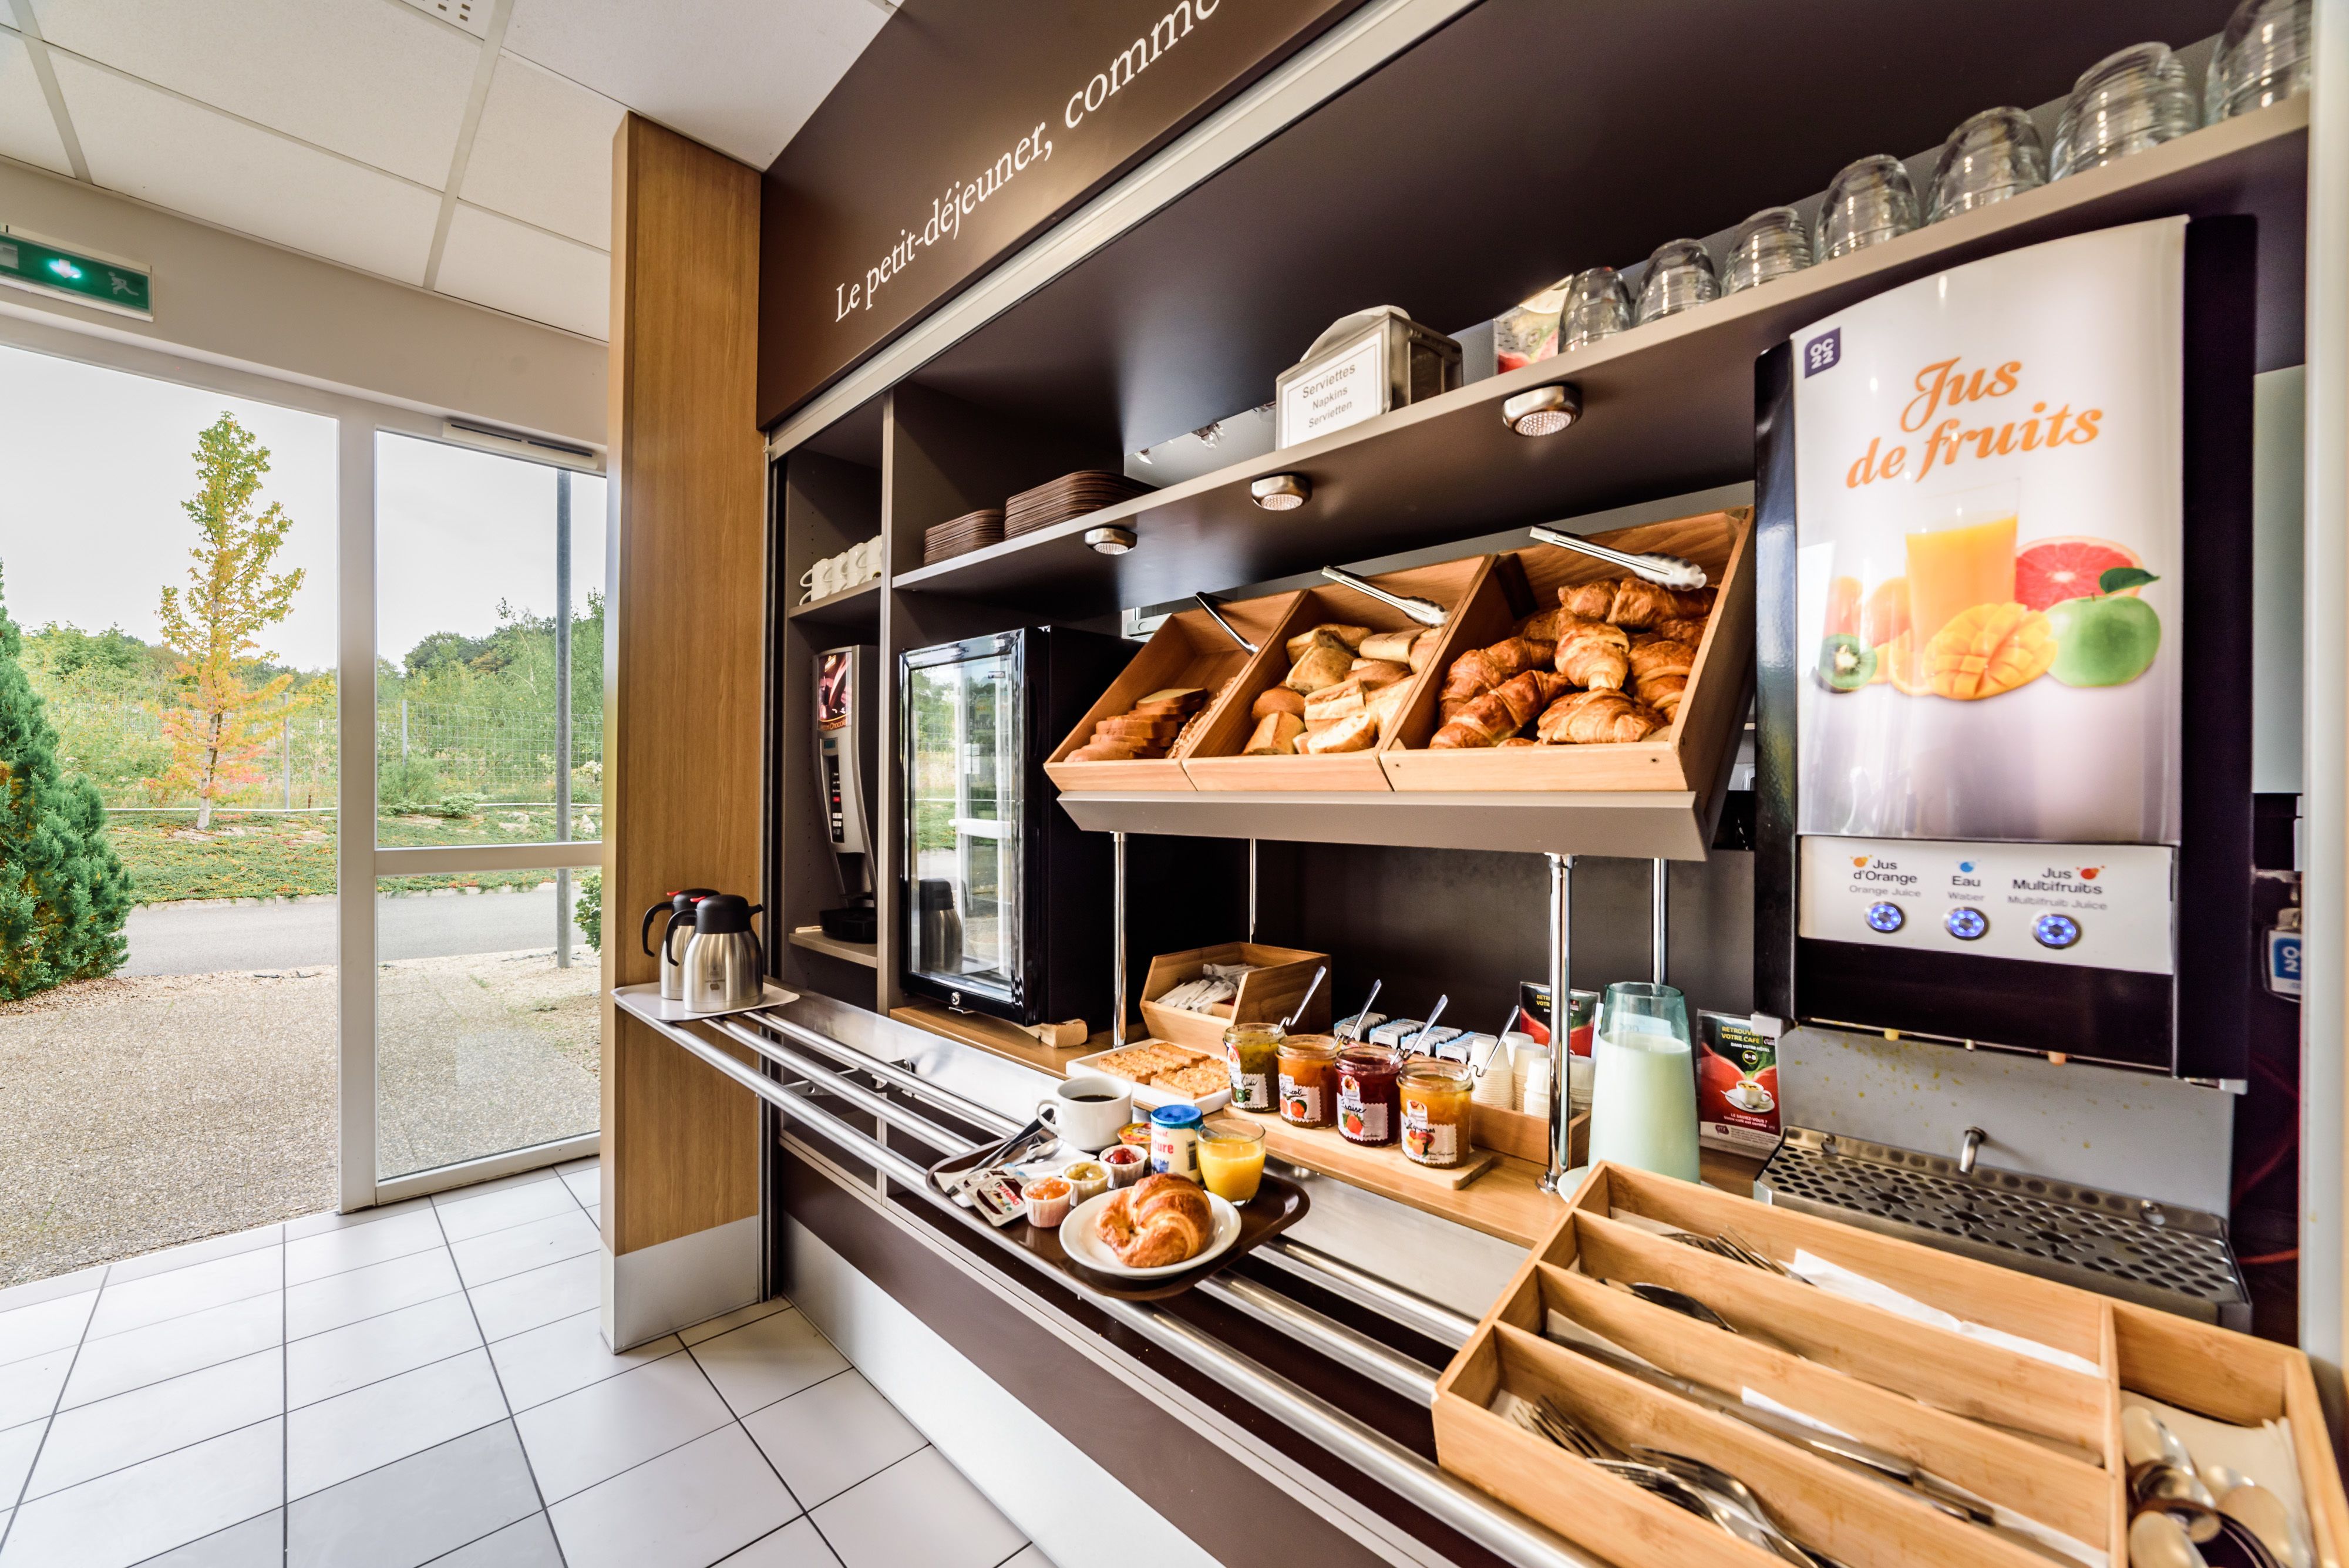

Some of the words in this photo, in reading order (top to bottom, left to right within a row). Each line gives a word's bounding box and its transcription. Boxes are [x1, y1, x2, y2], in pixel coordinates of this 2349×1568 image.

[835, 281, 861, 322] Le
[865, 122, 1054, 310] petit-déjeuner,
[1810, 338, 1835, 356] OC
[1812, 348, 1835, 369] 22
[1303, 364, 1355, 398] Serviettes
[1313, 387, 1348, 410] Napkins
[1900, 356, 2022, 433] Jus
[1308, 401, 1352, 428] Servietten
[1846, 438, 1906, 489] de
[1915, 401, 2103, 483] fruits
[1873, 859, 1897, 870] Jus
[1853, 870, 1917, 886] d'Orange
[1952, 876, 1981, 887] Eau
[2042, 868, 2072, 879] Jus
[1849, 884, 1889, 896] Orange
[1892, 888, 1921, 897] Juice
[2012, 879, 2103, 895] Multifruits
[2007, 896, 2068, 907] Multifruit
[2071, 900, 2108, 910] Juice
[1721, 1026, 1760, 1036] RETROUV
[1721, 1032, 1742, 1042] VOTRE
[995, 1182, 1020, 1206] nutella
